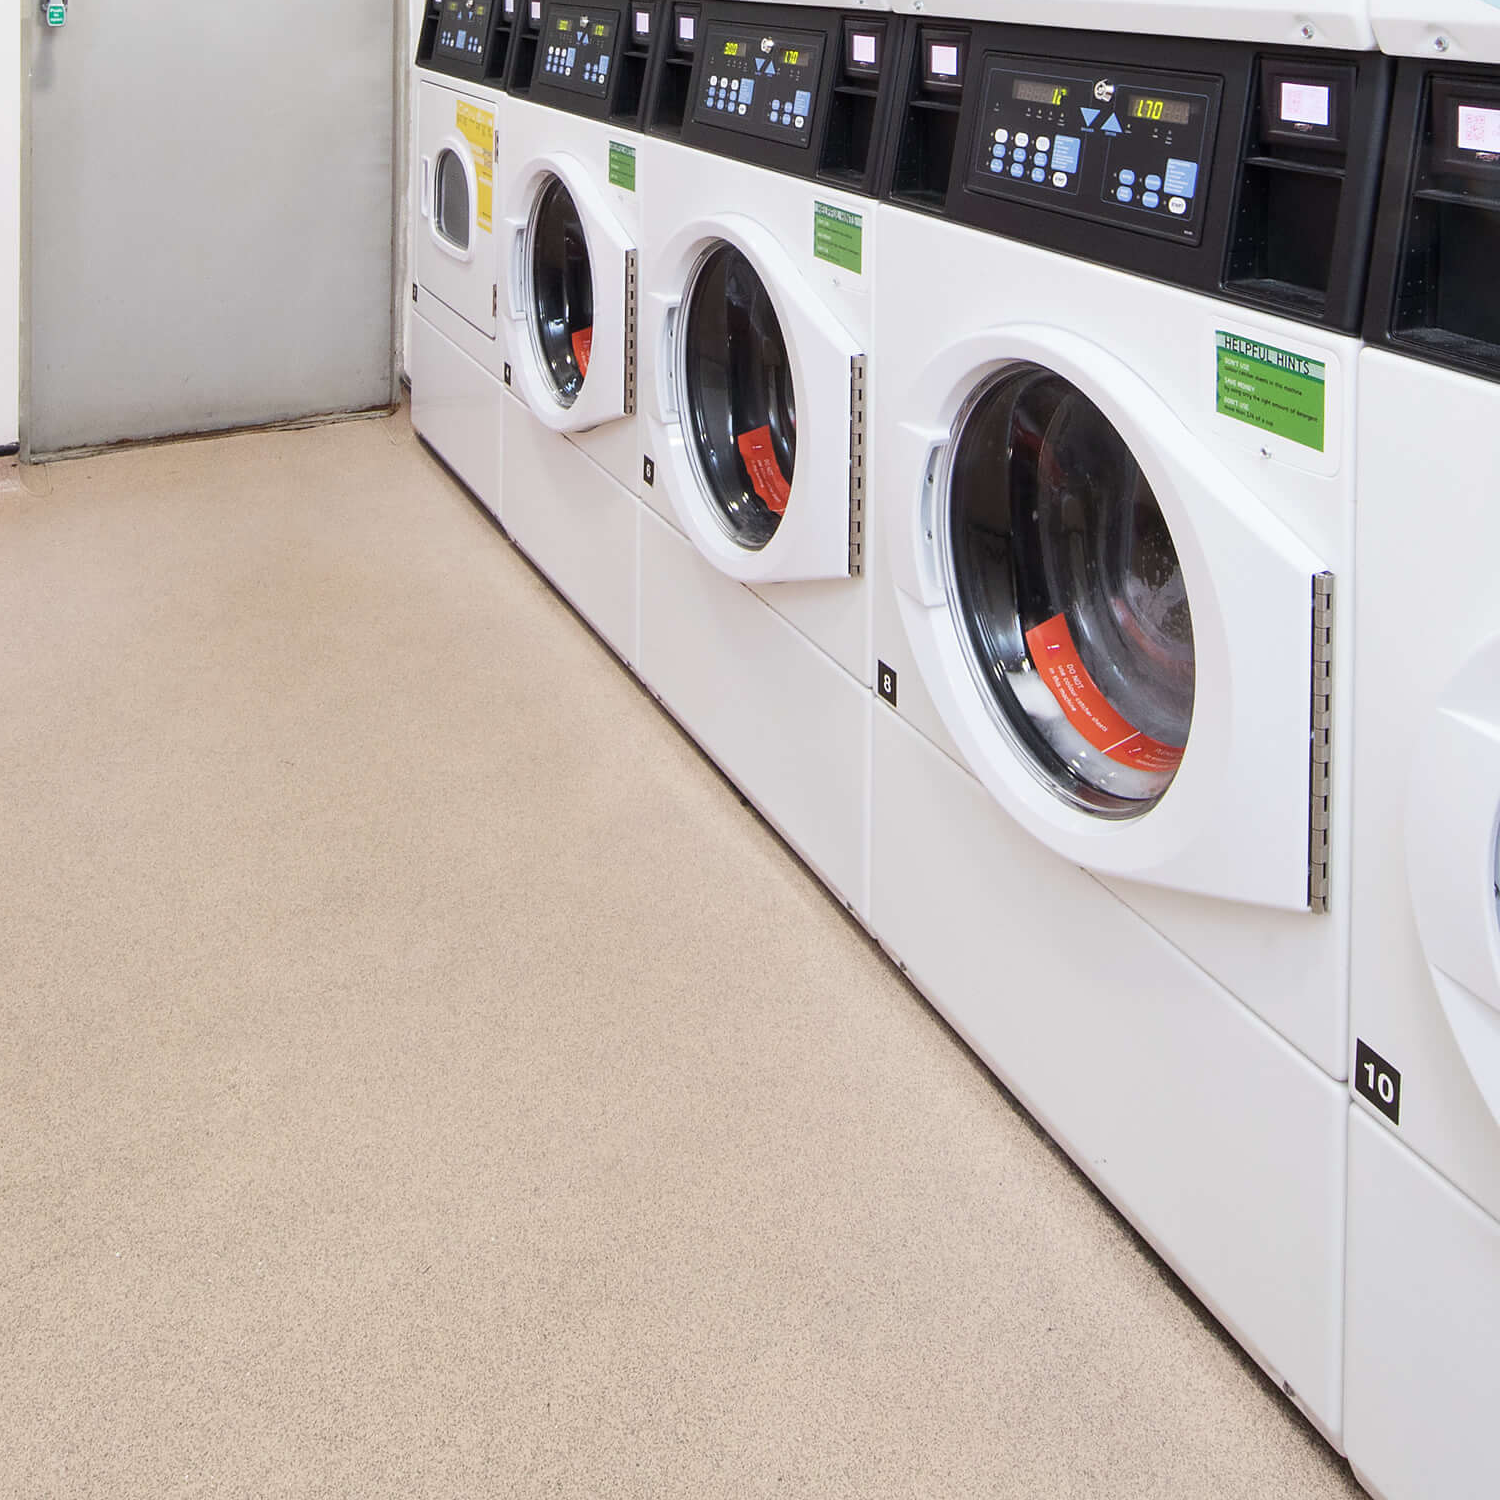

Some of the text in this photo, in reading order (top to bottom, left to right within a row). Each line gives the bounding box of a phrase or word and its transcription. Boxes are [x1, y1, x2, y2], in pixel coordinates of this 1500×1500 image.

[1224, 336, 1310, 375] HELPFUL HINTS
[883, 675, 891, 693] 8
[1364, 1062, 1394, 1103] 10
